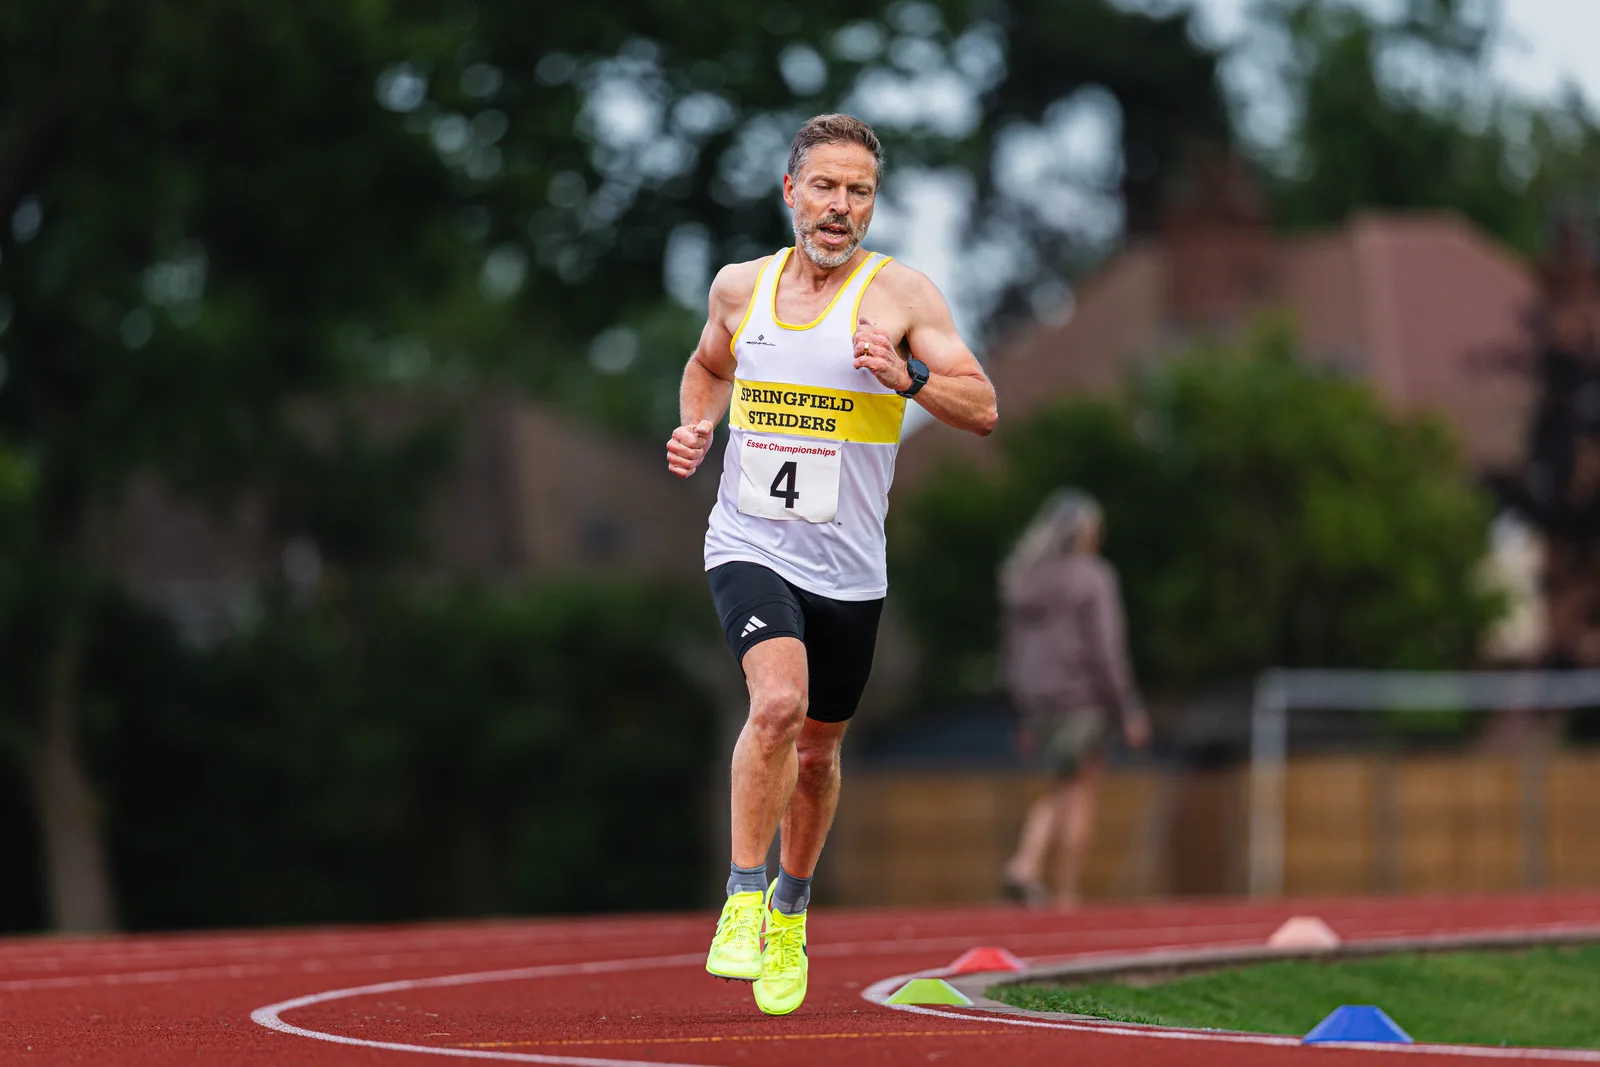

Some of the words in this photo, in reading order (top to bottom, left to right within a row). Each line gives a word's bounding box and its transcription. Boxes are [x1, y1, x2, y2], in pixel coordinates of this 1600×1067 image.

[741, 387, 854, 412] SPRINGFIELD
[748, 411, 836, 432] STRIDERS
[746, 439, 768, 450] Essex
[768, 442, 836, 457] Championships
[770, 461, 799, 509] 4
